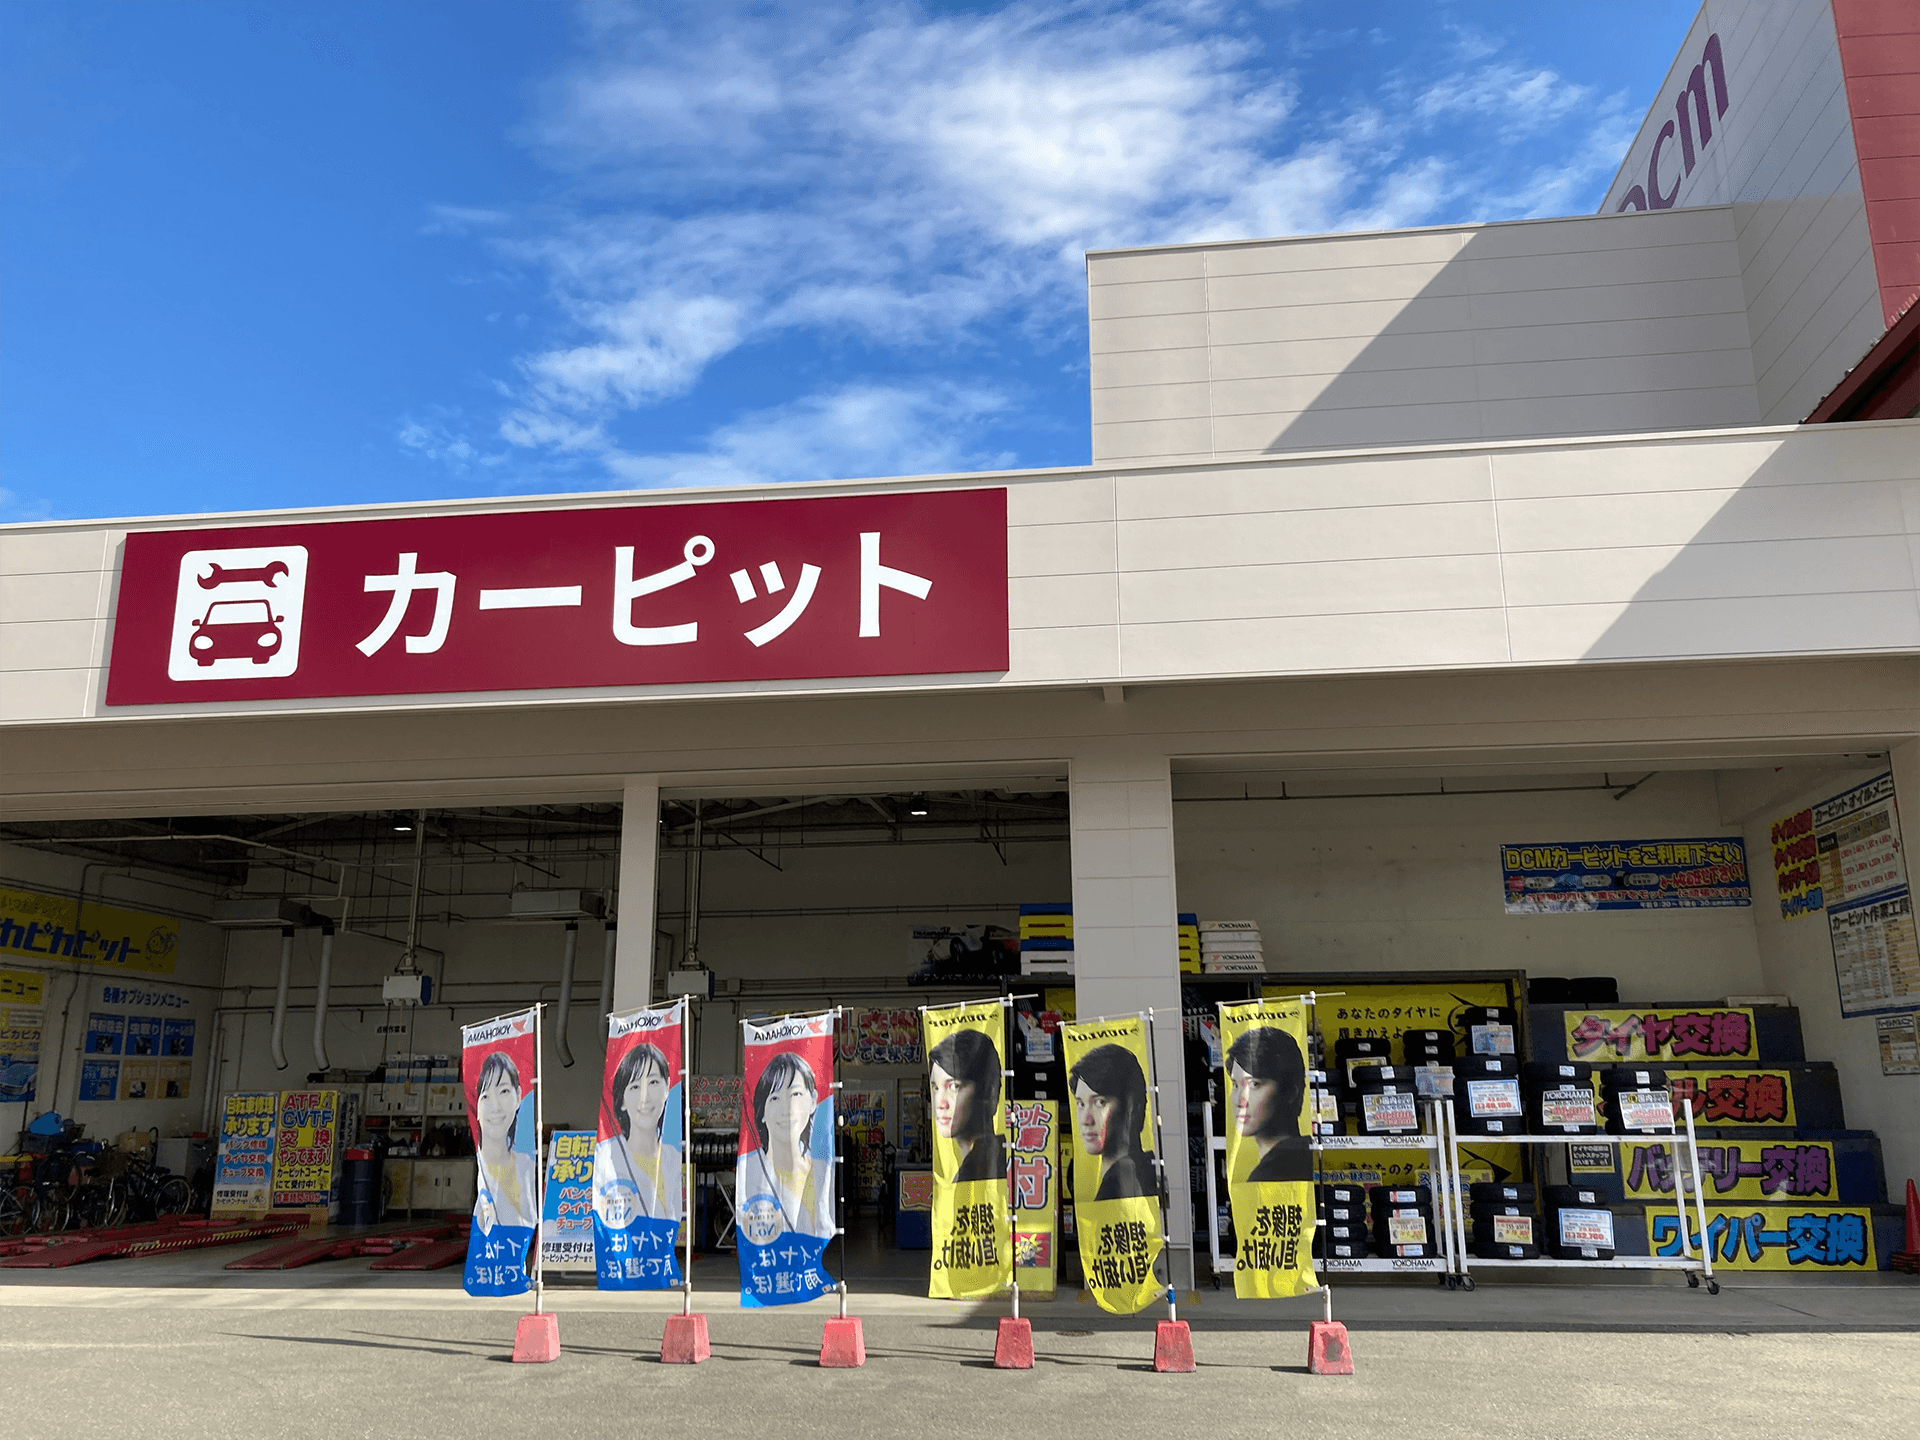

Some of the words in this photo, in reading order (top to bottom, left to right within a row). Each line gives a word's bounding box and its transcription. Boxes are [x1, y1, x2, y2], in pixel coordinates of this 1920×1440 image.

[356, 532, 933, 657] カーピット
[1815, 798, 1847, 823] カーピット
[1505, 843, 1742, 870] DCMカーピットをご利用下さい
[103, 986, 190, 1008] 各種オプションメニュー
[1336, 1006, 1441, 1020] あなたのタイヤに
[1338, 1026, 1412, 1039] 履きかえよ
[1571, 1011, 1752, 1058] タイヤ交換
[692, 1077, 744, 1090] スクータータ
[284, 1093, 320, 1110] ATF
[1544, 1092, 1590, 1100] YOKOHAMA
[226, 1096, 275, 1116] 自転車修理
[283, 1110, 333, 1127] CVTF
[835, 1109, 885, 1126] VTF
[223, 1116, 274, 1137] 承ります
[225, 1139, 267, 1151] パンク修理
[280, 1129, 332, 1147] 交換
[1382, 1136, 1425, 1144] YOKOHAMA
[224, 1153, 266, 1165] タイヤ交換
[280, 1149, 332, 1166] やってます!
[277, 1168, 330, 1178] カーピットコーナー
[551, 1159, 593, 1183] 承り
[276, 1179, 317, 1190] にて受付中!
[558, 1201, 593, 1215] タイヤ
[1651, 1212, 1869, 1265] ワイパー交換
[1318, 1259, 1363, 1267] YOKOHAMA
[1391, 1259, 1435, 1267] YOKOHAMA
